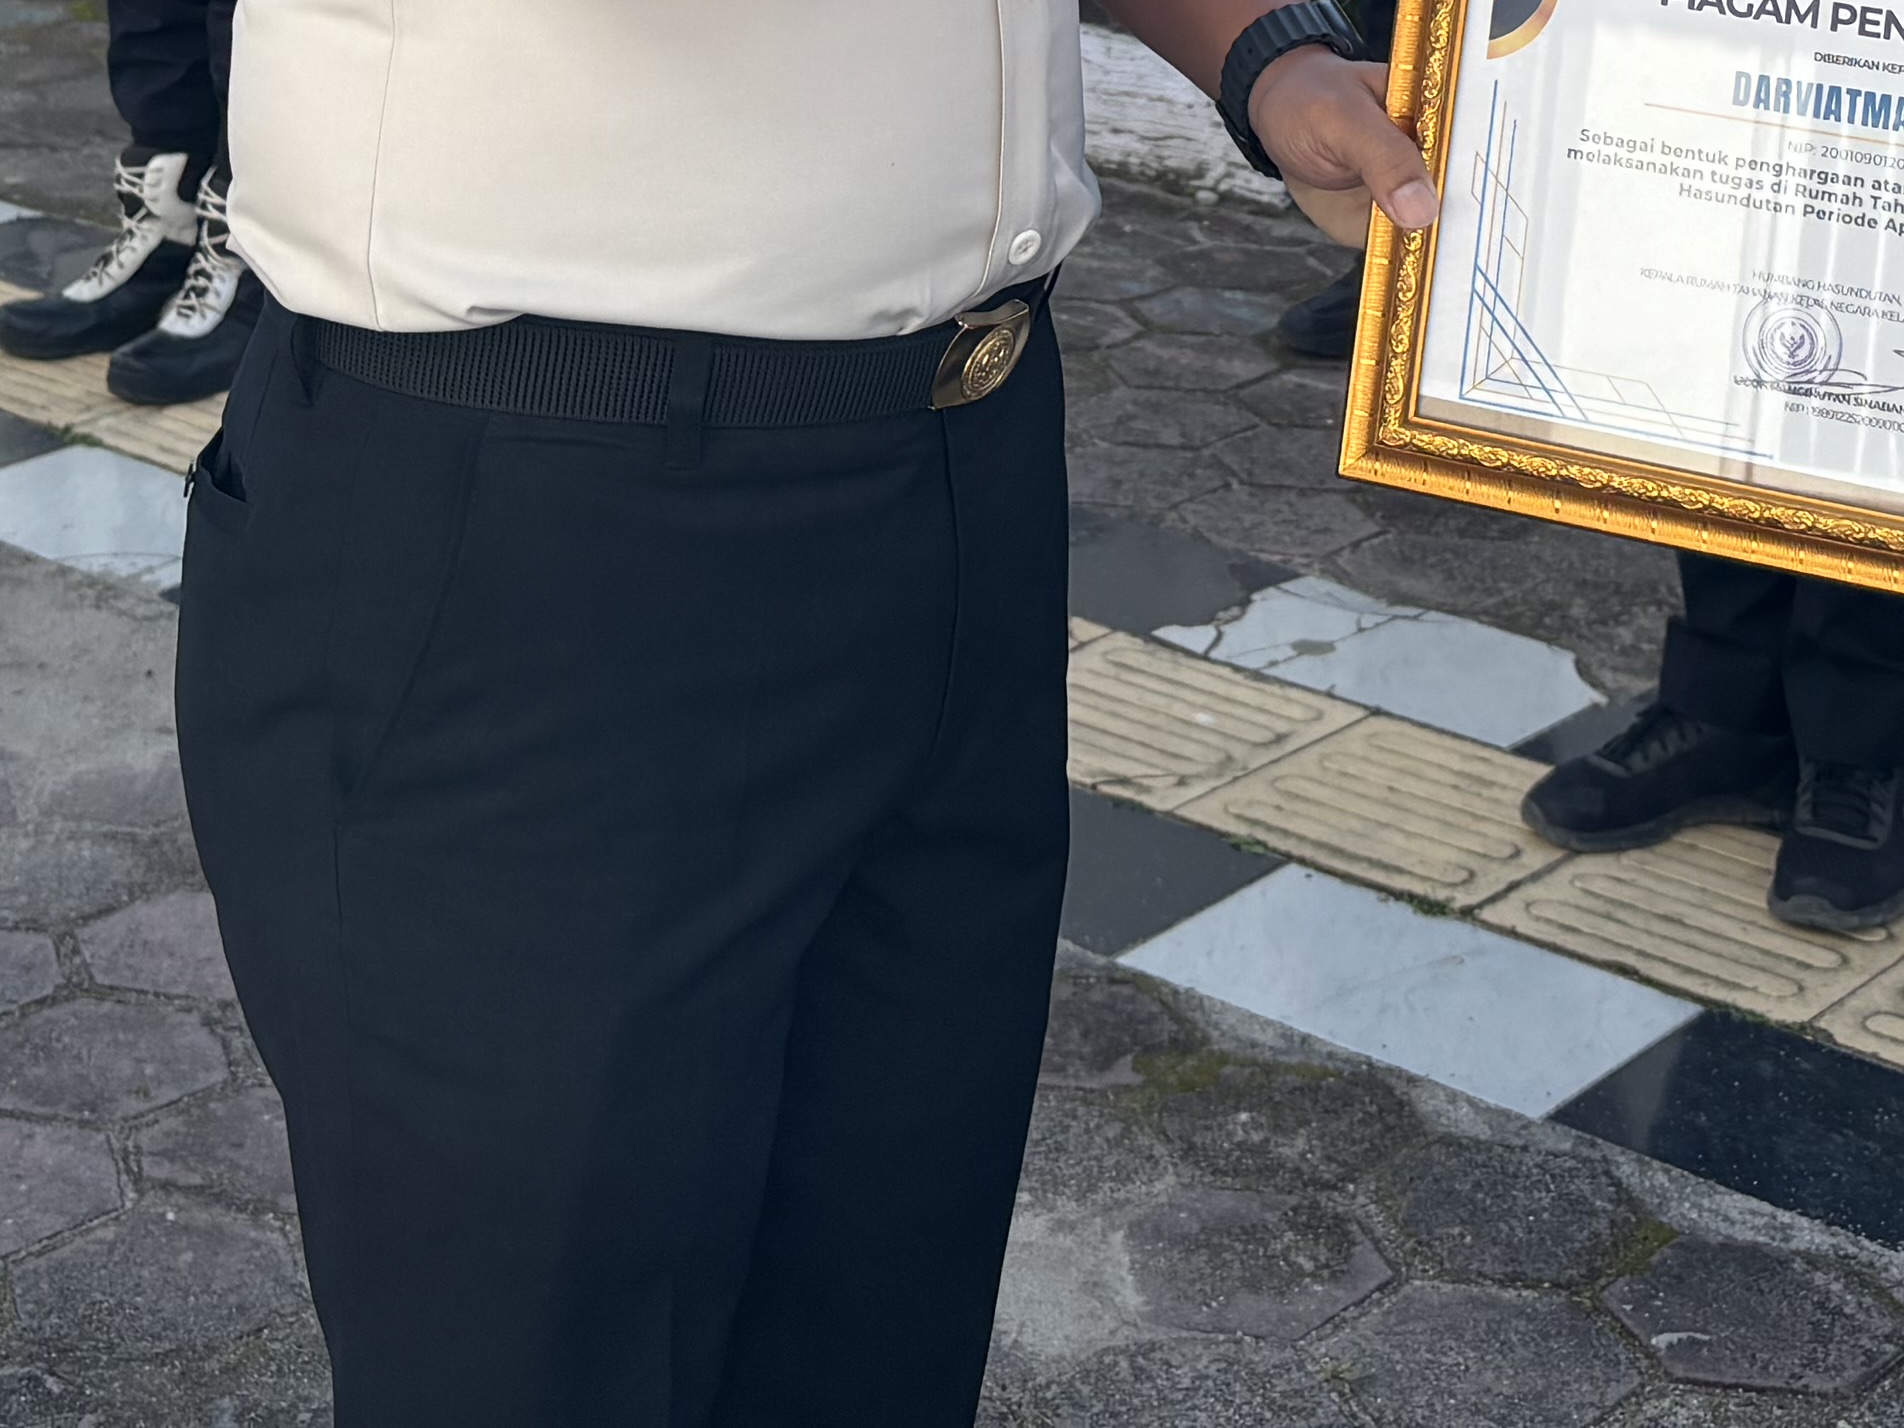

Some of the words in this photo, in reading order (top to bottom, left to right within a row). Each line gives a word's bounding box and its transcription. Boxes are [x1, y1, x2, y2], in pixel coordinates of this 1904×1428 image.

[1813, 51, 1880, 73] DIBERIKAN
[1566, 147, 1704, 181] melaksanakan
[1710, 169, 1764, 191] tugas
[1770, 177, 1789, 196] di
[1795, 183, 1863, 208] Rumah
[1579, 128, 1655, 155] Sebagai
[1660, 141, 1729, 167] bentuk
[1735, 157, 1865, 190] penghargaan
[1678, 182, 1796, 216] Hasundutan
[1802, 203, 1879, 229] Periode
